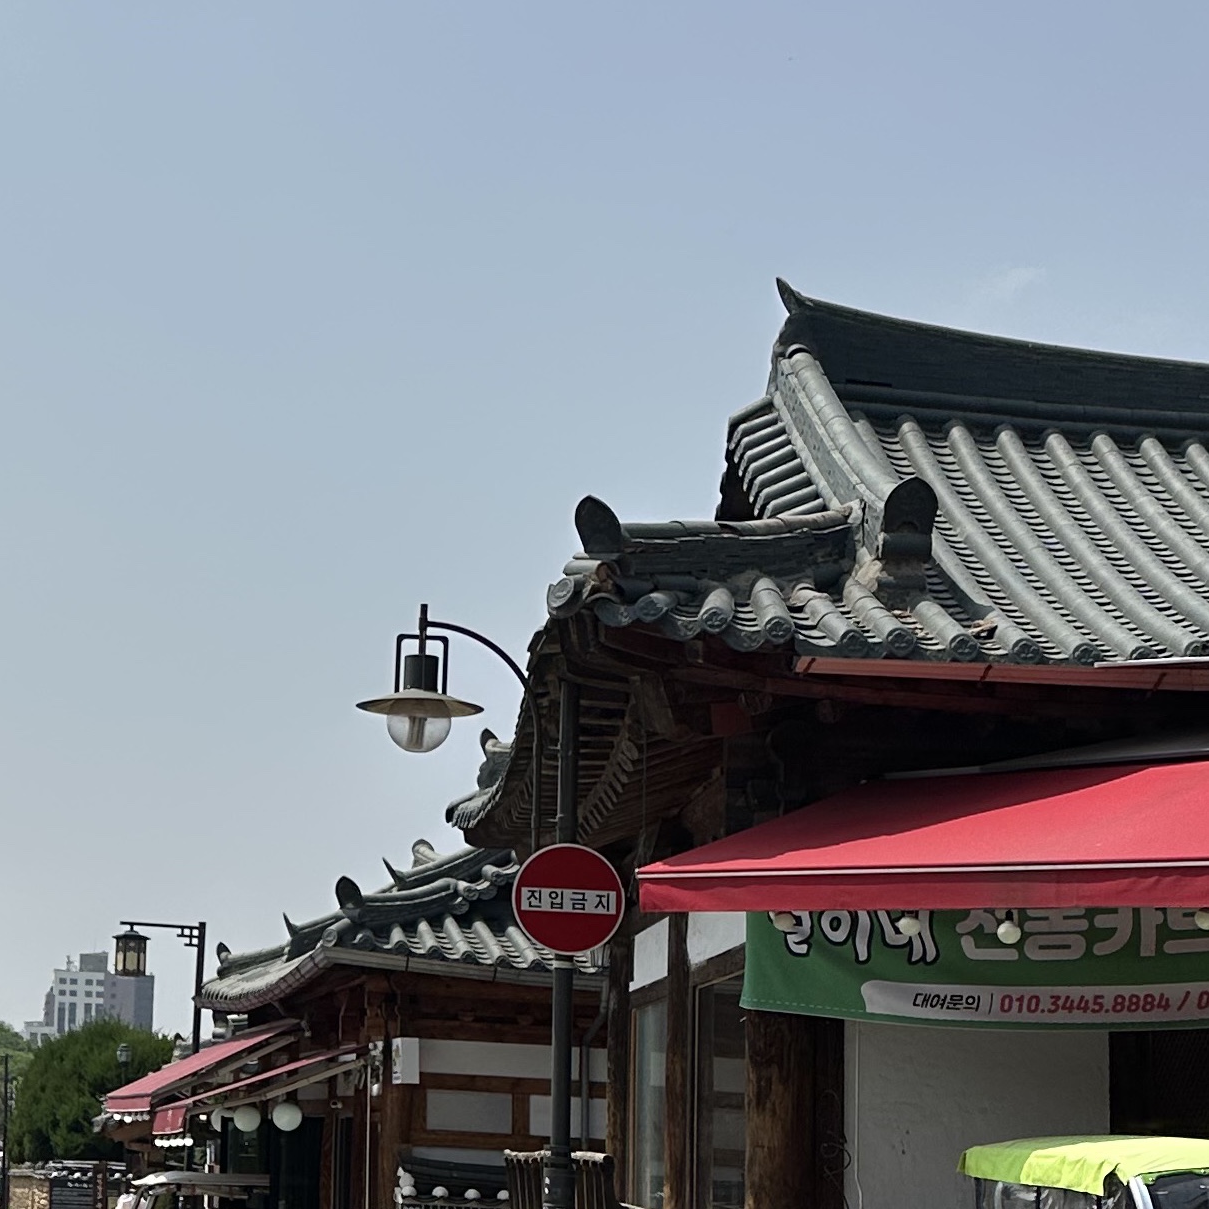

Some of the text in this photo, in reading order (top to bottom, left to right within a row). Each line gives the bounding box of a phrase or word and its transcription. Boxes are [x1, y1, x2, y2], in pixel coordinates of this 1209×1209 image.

[526, 889, 610, 912] 진입금지
[912, 992, 981, 1012] 대여문의
[999, 993, 1171, 1014] 010.3445.8884
